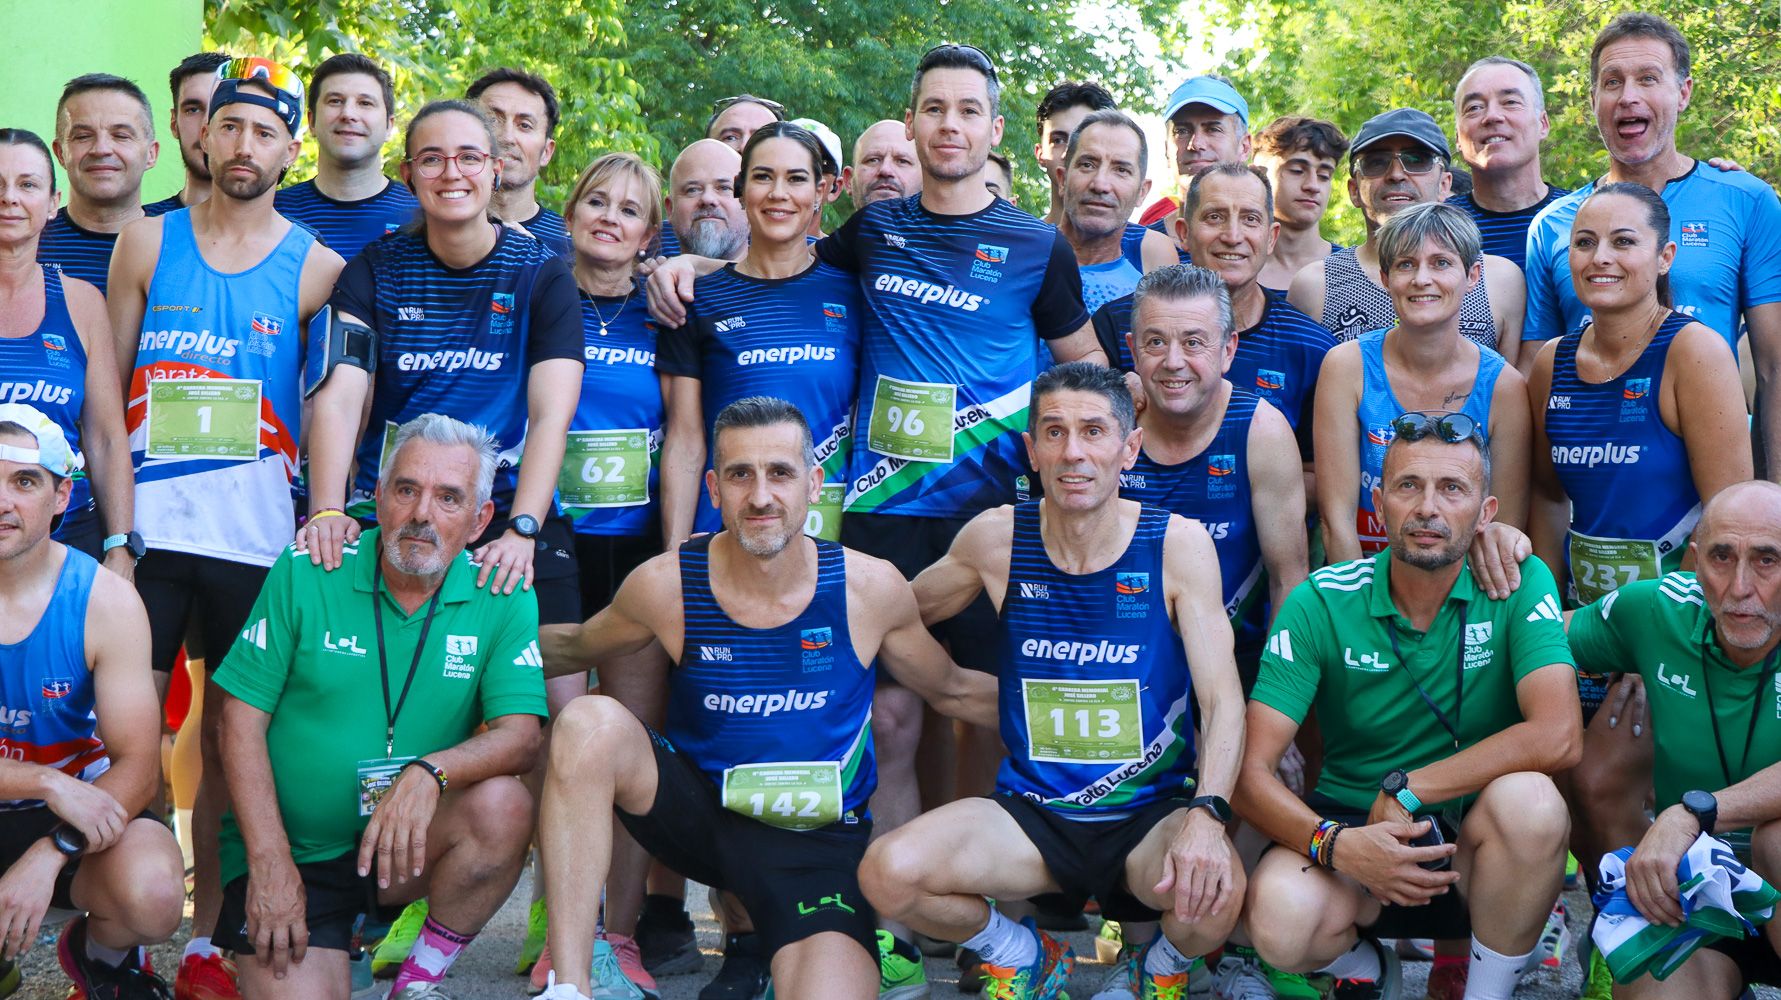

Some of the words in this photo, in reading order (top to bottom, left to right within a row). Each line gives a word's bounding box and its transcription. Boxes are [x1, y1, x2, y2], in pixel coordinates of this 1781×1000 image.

[973, 259, 991, 269] Club
[971, 265, 1003, 278] Maratón
[970, 271, 999, 284] Lucena
[875, 273, 984, 312] enerplus
[410, 313, 425, 321] PRO
[491, 314, 507, 322] Club
[727, 316, 743, 325] RUN
[490, 320, 515, 329] Maratón
[730, 320, 747, 329] PRO
[489, 327, 513, 335] Lucena
[181, 352, 231, 366] directo
[585, 345, 656, 367] erplus
[737, 343, 836, 366] enerplus
[398, 347, 504, 373] enerplus
[0, 380, 73, 404] rplus
[1557, 402, 1571, 410] PRO
[1620, 406, 1648, 416] Maratón
[197, 406, 213, 433] 1
[888, 405, 925, 436] 96
[1619, 413, 1646, 423] Lucena
[814, 425, 849, 462] Lucna
[1551, 443, 1640, 468] enerplus
[582, 456, 626, 483] 62
[856, 464, 887, 494] Club
[1130, 481, 1146, 489] PRO
[1207, 483, 1237, 492] Maratón
[1207, 491, 1235, 499] Lucena
[1580, 559, 1640, 591] 237
[1033, 583, 1049, 592] RUN
[1035, 590, 1050, 600] PRO
[1116, 594, 1136, 603] Club
[1116, 601, 1150, 611] Maratón
[1116, 610, 1147, 619] Lucena
[1021, 638, 1140, 666] enerplus
[1464, 644, 1483, 653] Club
[446, 654, 464, 664] Club
[716, 654, 733, 662] PRO
[802, 650, 821, 659] Club
[1463, 649, 1494, 662] Maratón
[802, 656, 835, 666] Maratón
[1463, 658, 1492, 670] Lucena
[444, 661, 475, 673] Maratón
[802, 664, 832, 674] Lucena
[443, 669, 471, 680] Lucena
[703, 689, 829, 717] enerplus
[1050, 708, 1121, 738] 113
[1070, 784, 1111, 806] ratón
[1106, 741, 1163, 786] Lucena
[750, 791, 822, 816] 142
